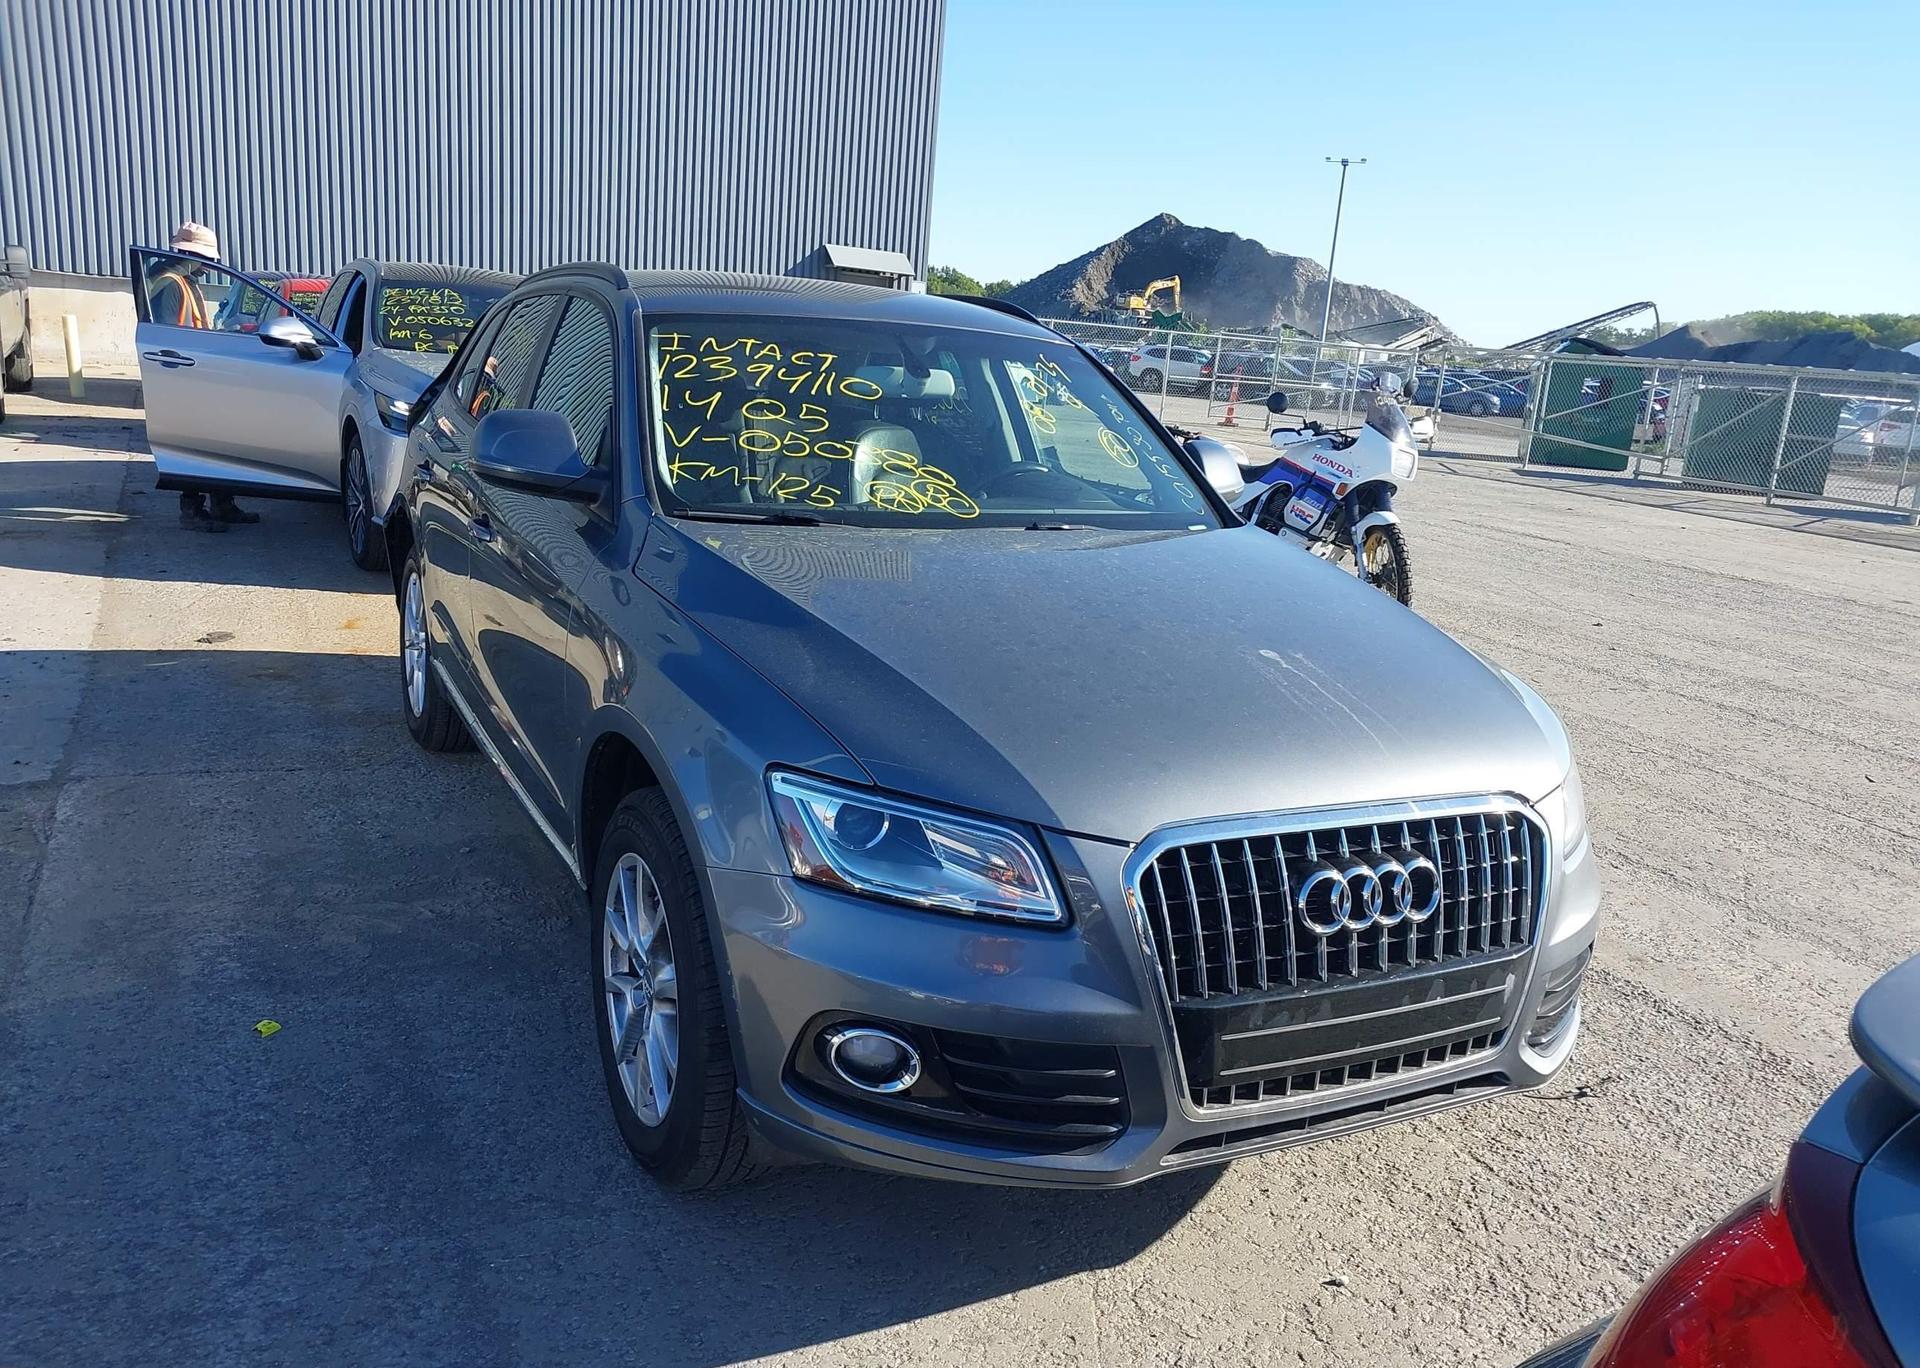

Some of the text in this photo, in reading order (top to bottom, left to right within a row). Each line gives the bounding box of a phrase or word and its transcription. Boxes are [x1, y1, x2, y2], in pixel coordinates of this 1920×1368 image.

[651, 332, 838, 370] INTACT
[741, 398, 829, 433] Q5
[1312, 453, 1354, 478] HONDA
